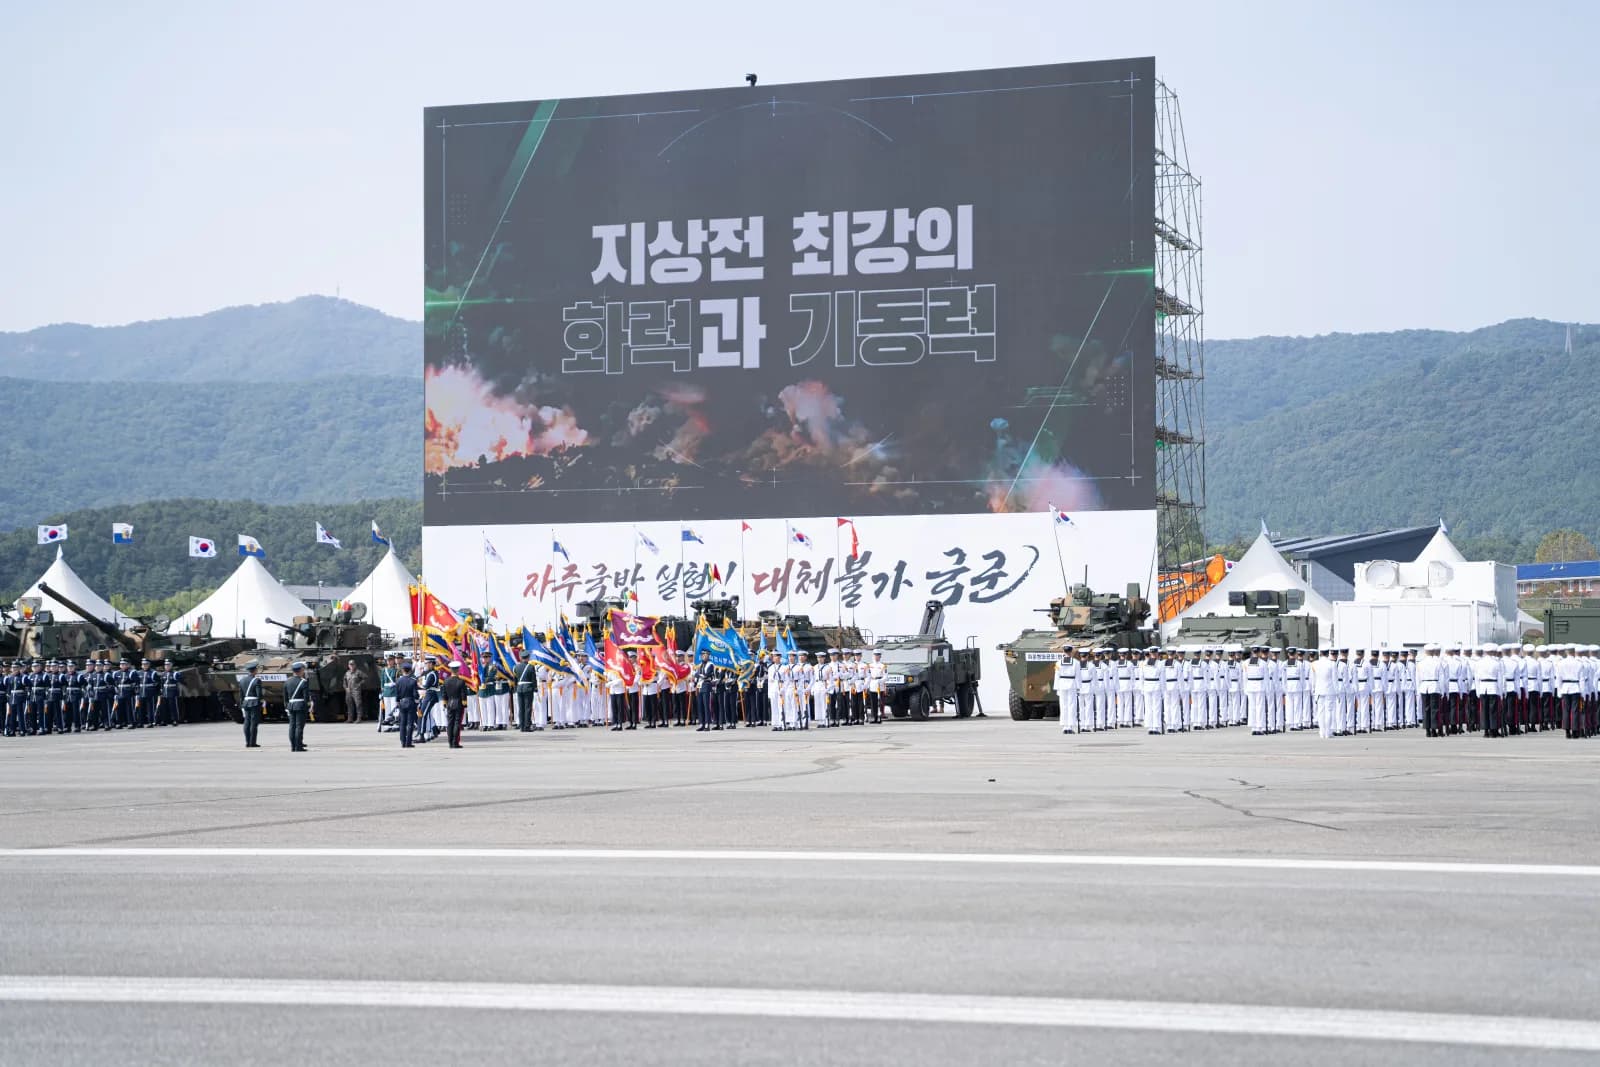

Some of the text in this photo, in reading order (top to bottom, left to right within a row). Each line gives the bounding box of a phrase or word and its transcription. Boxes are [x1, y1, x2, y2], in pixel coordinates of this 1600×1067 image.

[591, 203, 974, 286] 지상전 최강의
[561, 283, 997, 375] 화력과 기동력
[522, 544, 1040, 609] 자주국방 실현! 대체불가 국군
